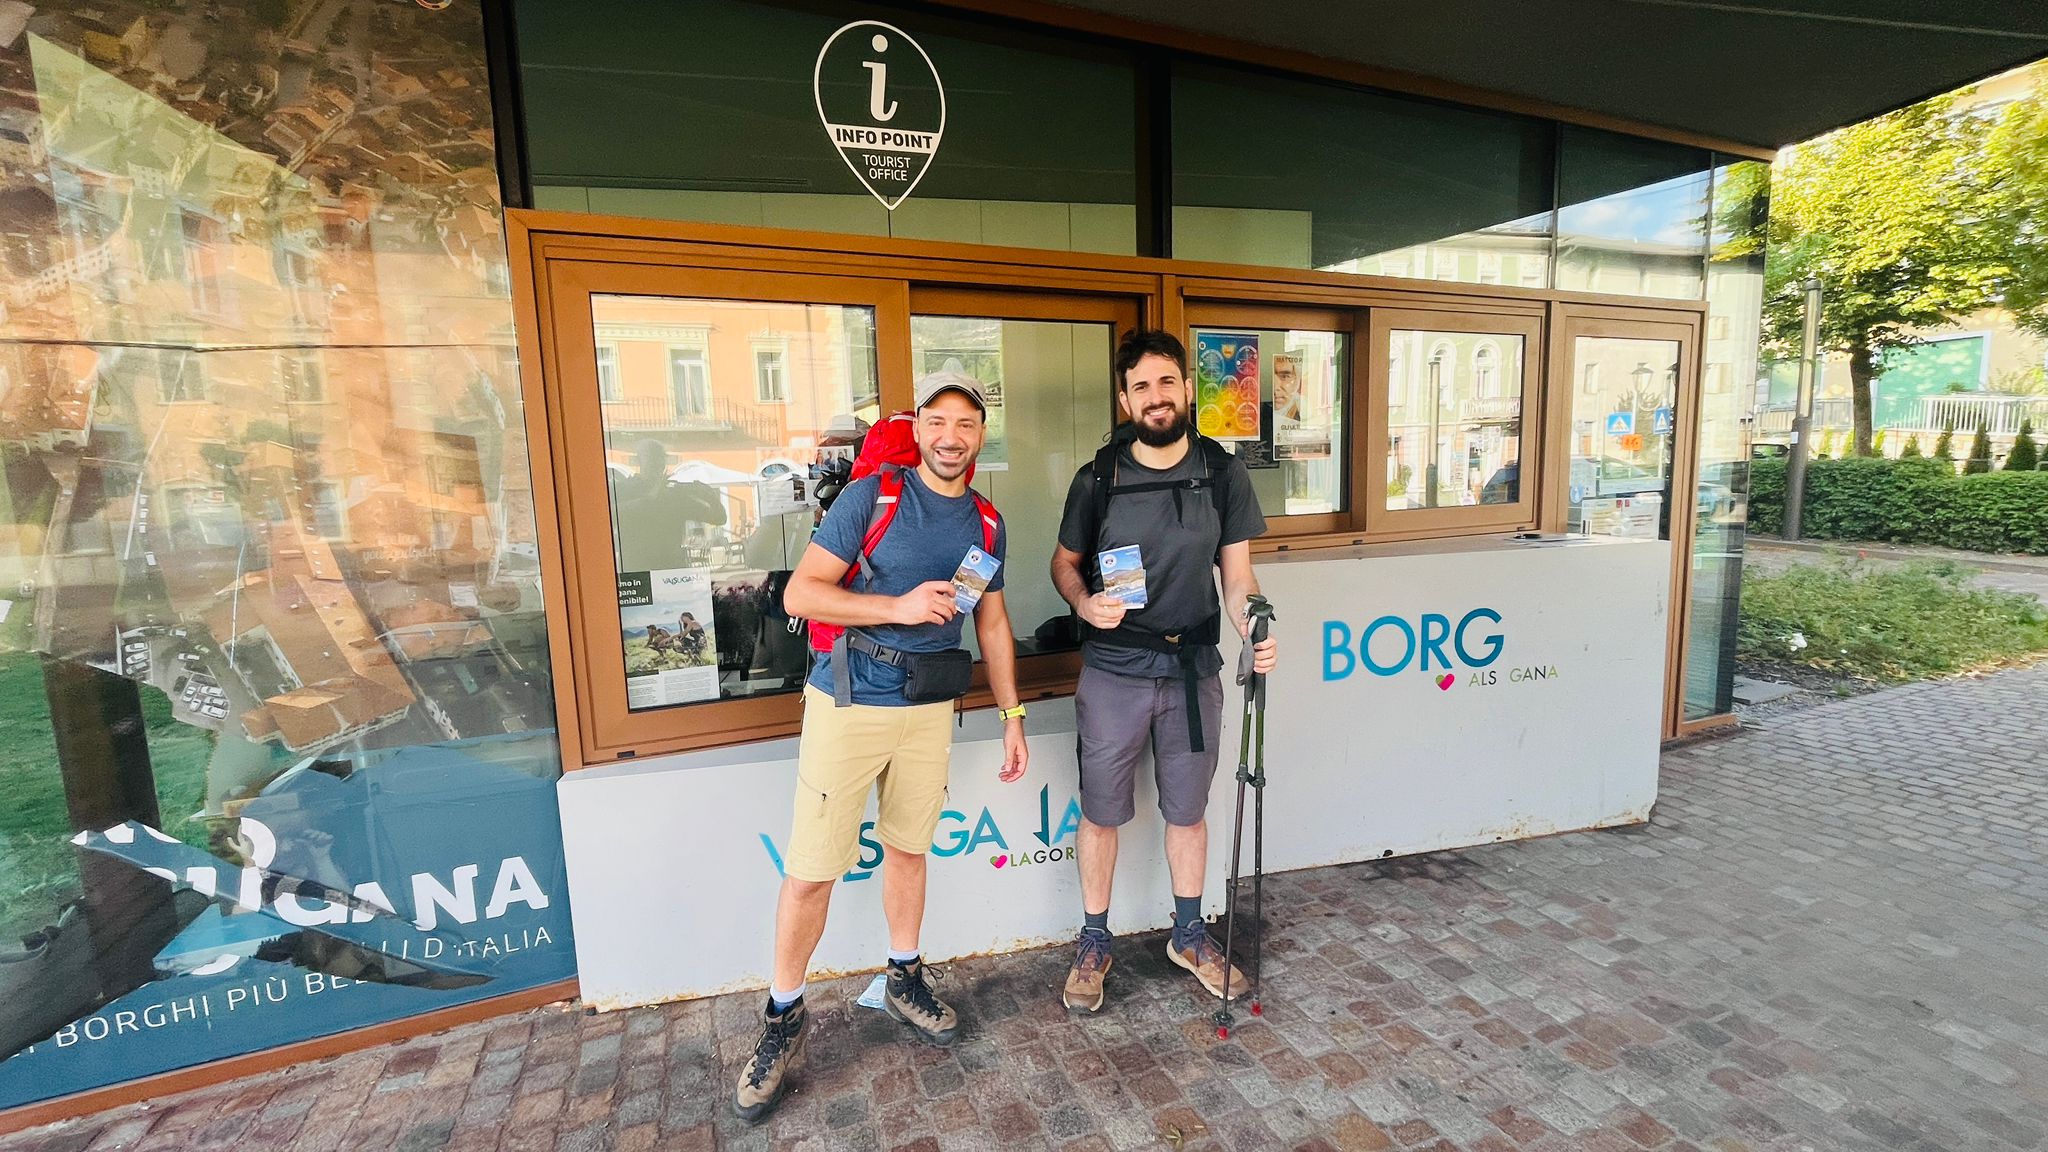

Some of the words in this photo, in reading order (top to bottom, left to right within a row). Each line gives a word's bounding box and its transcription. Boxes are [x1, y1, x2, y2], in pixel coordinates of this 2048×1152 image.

[862, 34, 898, 122] i
[836, 128, 877, 145] INFO
[881, 132, 933, 149] POINT
[862, 154, 911, 168] TOURIST
[869, 168, 908, 181] OFFICE
[1323, 608, 1504, 681] BORG
[1010, 846, 1077, 867] LAGOR
[55, 994, 210, 1048] BORGHI
[227, 976, 288, 1011] PIÙ
